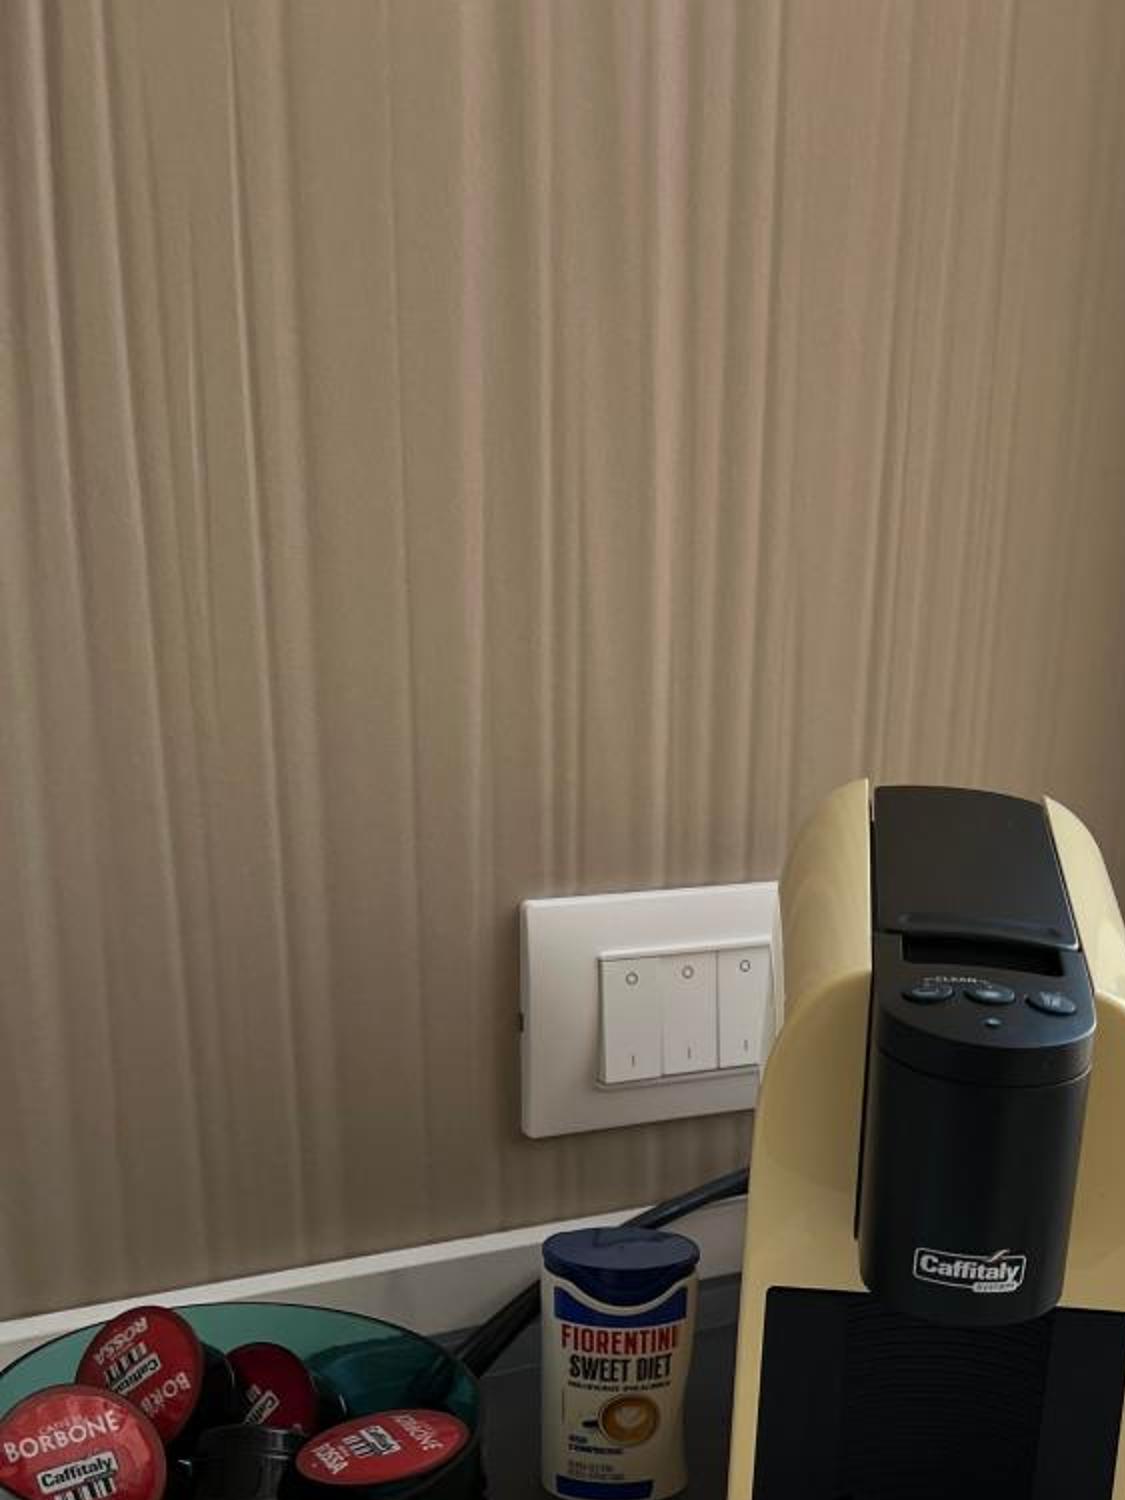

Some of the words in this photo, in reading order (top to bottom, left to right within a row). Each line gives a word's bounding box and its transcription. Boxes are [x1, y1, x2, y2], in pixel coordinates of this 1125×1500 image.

[919, 1254, 1020, 1283] Caffitaly
[92, 1315, 149, 1365] ROSSA
[561, 1323, 679, 1356] FIORENTINI
[569, 1353, 631, 1383] SWEET
[636, 1352, 673, 1382] DIET
[3, 1409, 120, 1464] BORBONE
[41, 1455, 114, 1488] Caffitaly
